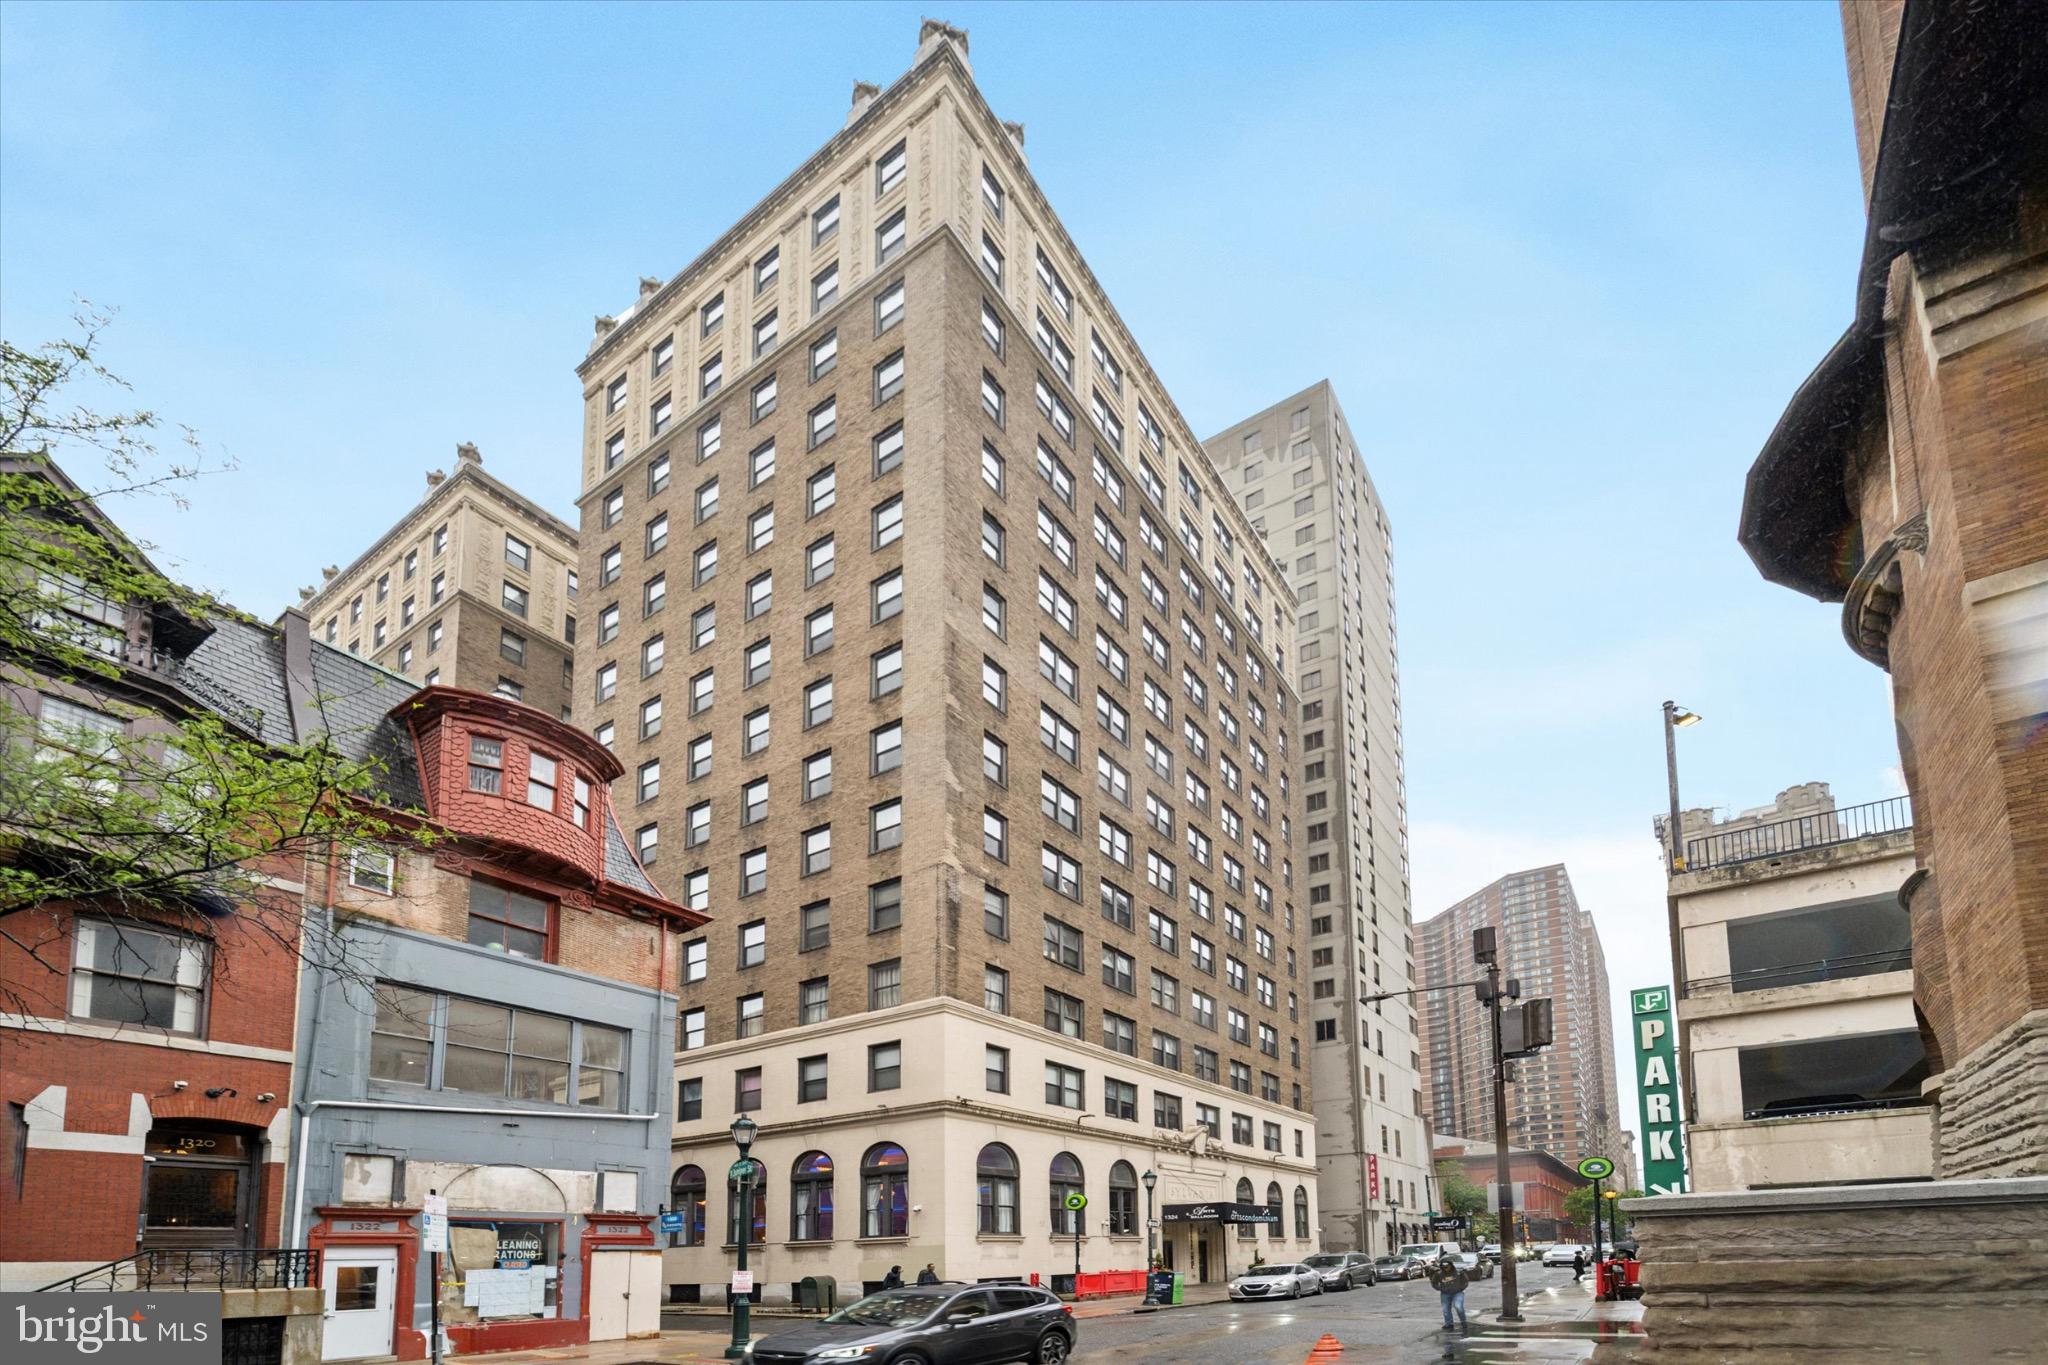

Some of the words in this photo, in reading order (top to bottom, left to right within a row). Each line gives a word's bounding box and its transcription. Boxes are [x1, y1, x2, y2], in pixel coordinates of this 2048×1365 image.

[1640, 1019, 1678, 1162] PARK
[179, 1137, 217, 1150] 1320
[1369, 1154, 1377, 1188] PARK
[350, 1222, 381, 1231] 1322
[496, 1240, 539, 1250] LEANING
[495, 1250, 536, 1260] RATIONS
